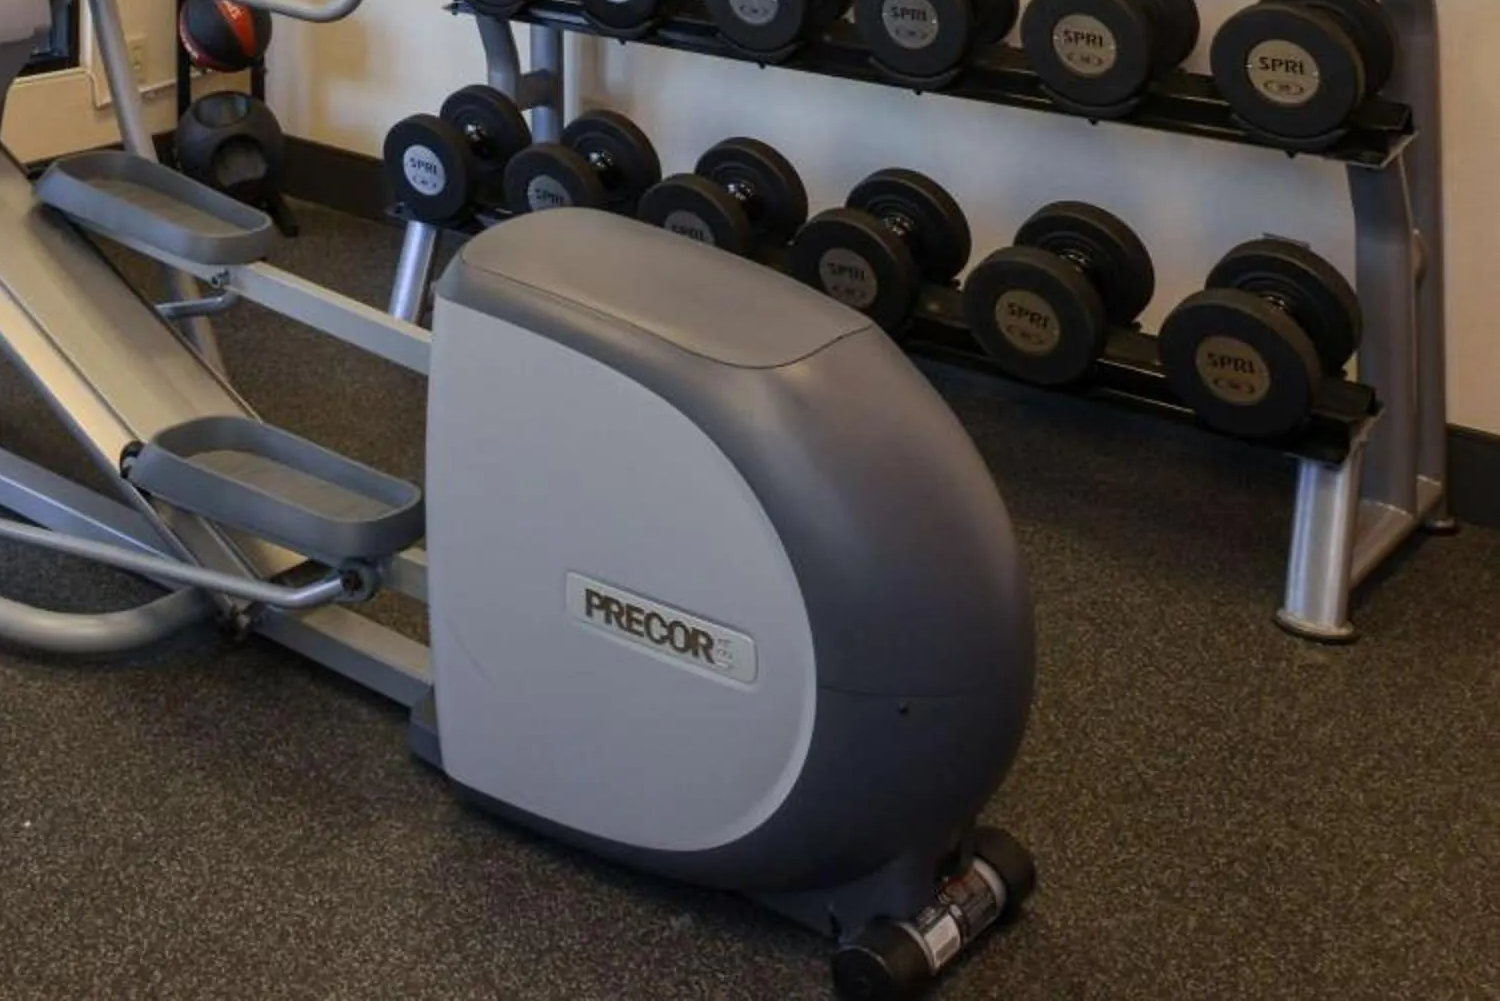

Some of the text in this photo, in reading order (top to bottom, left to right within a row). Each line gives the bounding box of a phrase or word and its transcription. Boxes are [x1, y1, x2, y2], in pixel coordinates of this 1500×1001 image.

[1062, 30, 1103, 48] SPRI
[1259, 56, 1304, 76] SPRI
[410, 158, 437, 175] SPRI
[1007, 302, 1047, 329] SPRI
[1208, 352, 1255, 375] SPRI
[584, 588, 715, 664] PRECOR
